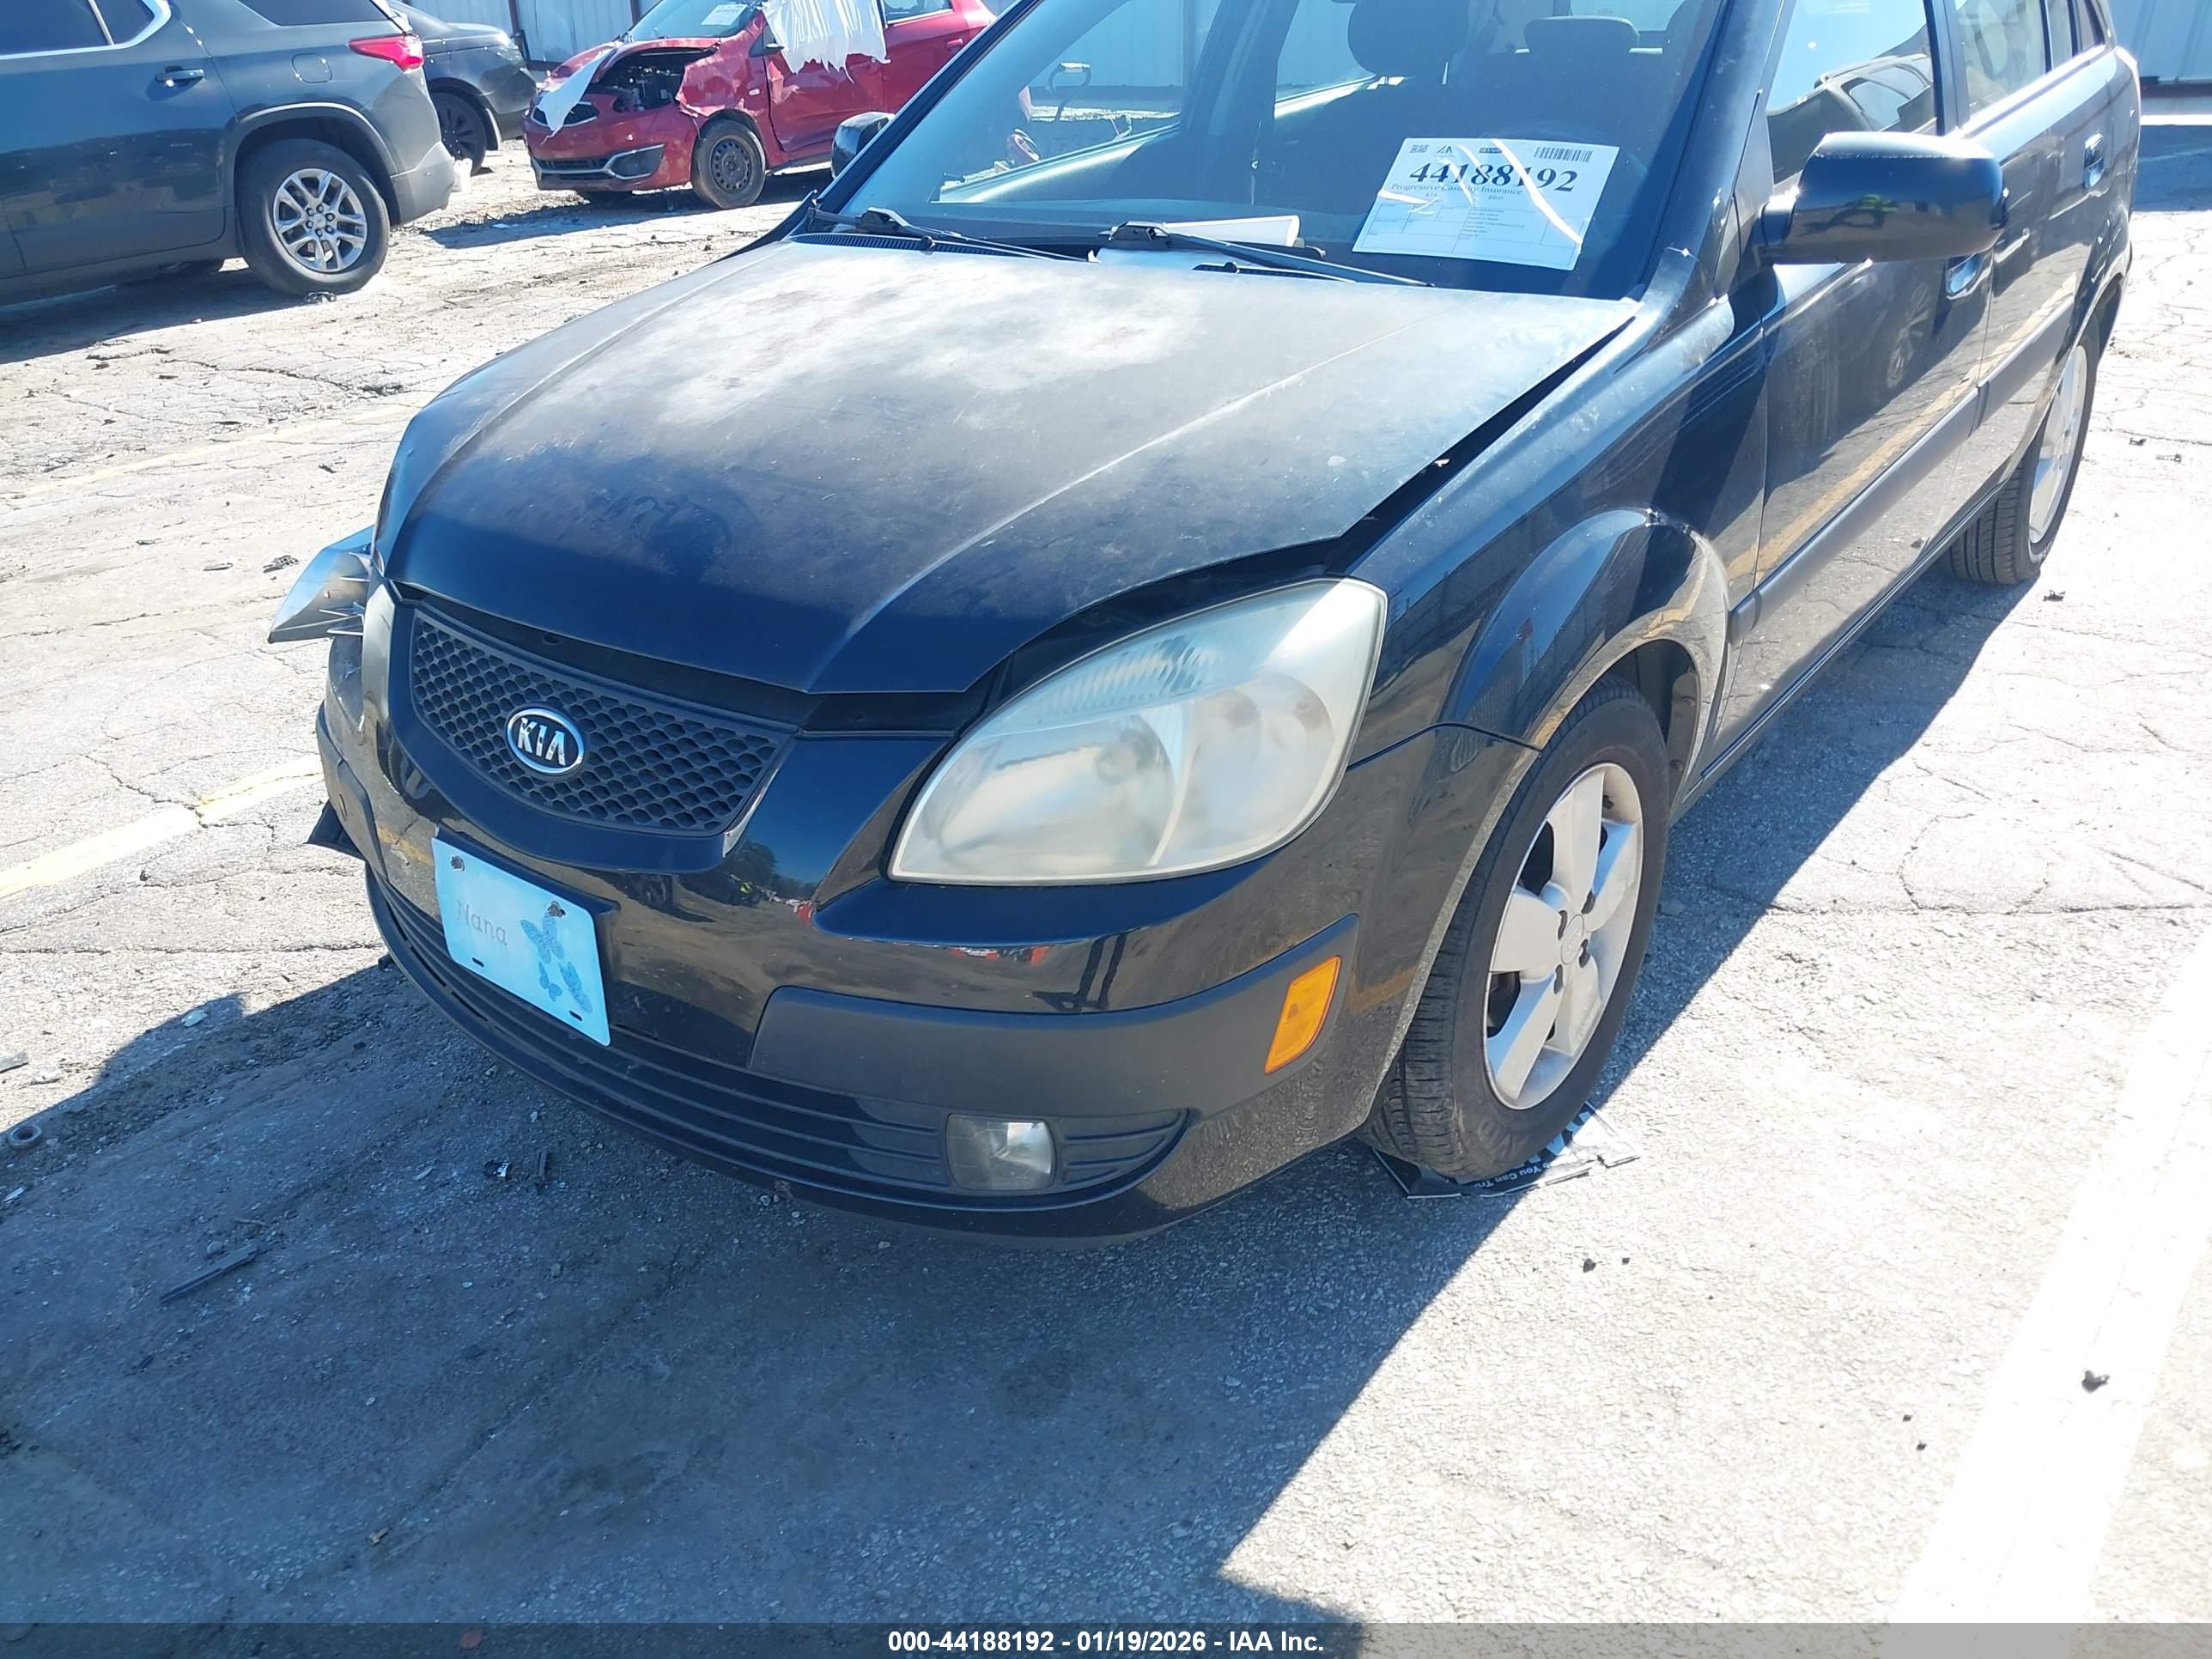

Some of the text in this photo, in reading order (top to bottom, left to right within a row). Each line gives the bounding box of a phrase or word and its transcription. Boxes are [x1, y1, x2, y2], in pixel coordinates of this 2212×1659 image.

[1480, 185, 1523, 195] Insurance
[518, 717, 566, 766] KIA
[456, 899, 507, 946] Nana
[1519, 1166, 1542, 1176] You
[1495, 1173, 1518, 1182] Can
